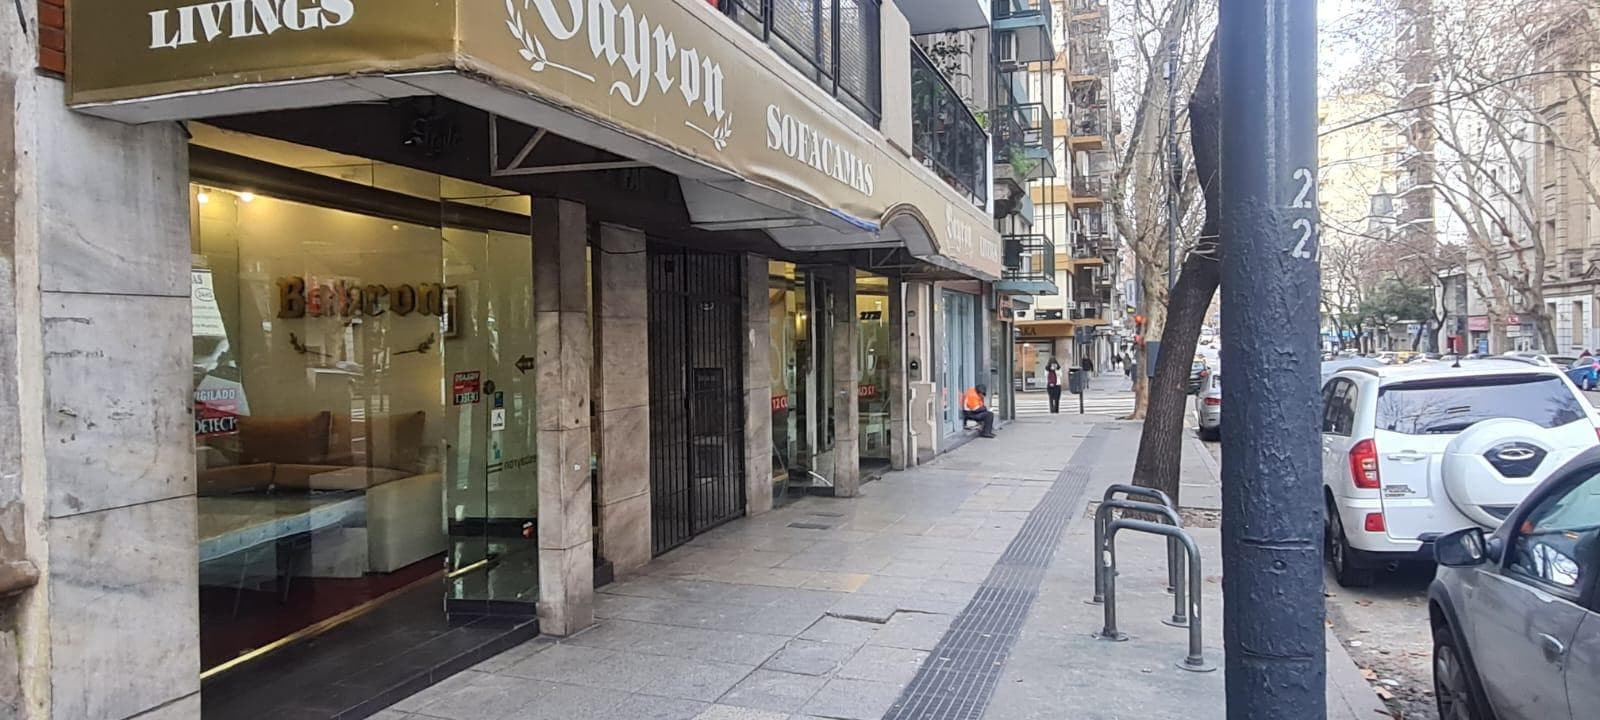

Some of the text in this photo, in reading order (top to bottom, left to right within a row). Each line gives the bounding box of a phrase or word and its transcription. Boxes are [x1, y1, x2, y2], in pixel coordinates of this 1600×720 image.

[148, 0, 354, 49] LIVINGS
[767, 104, 874, 197] SOFACAMAS
[1292, 168, 1313, 208] 2
